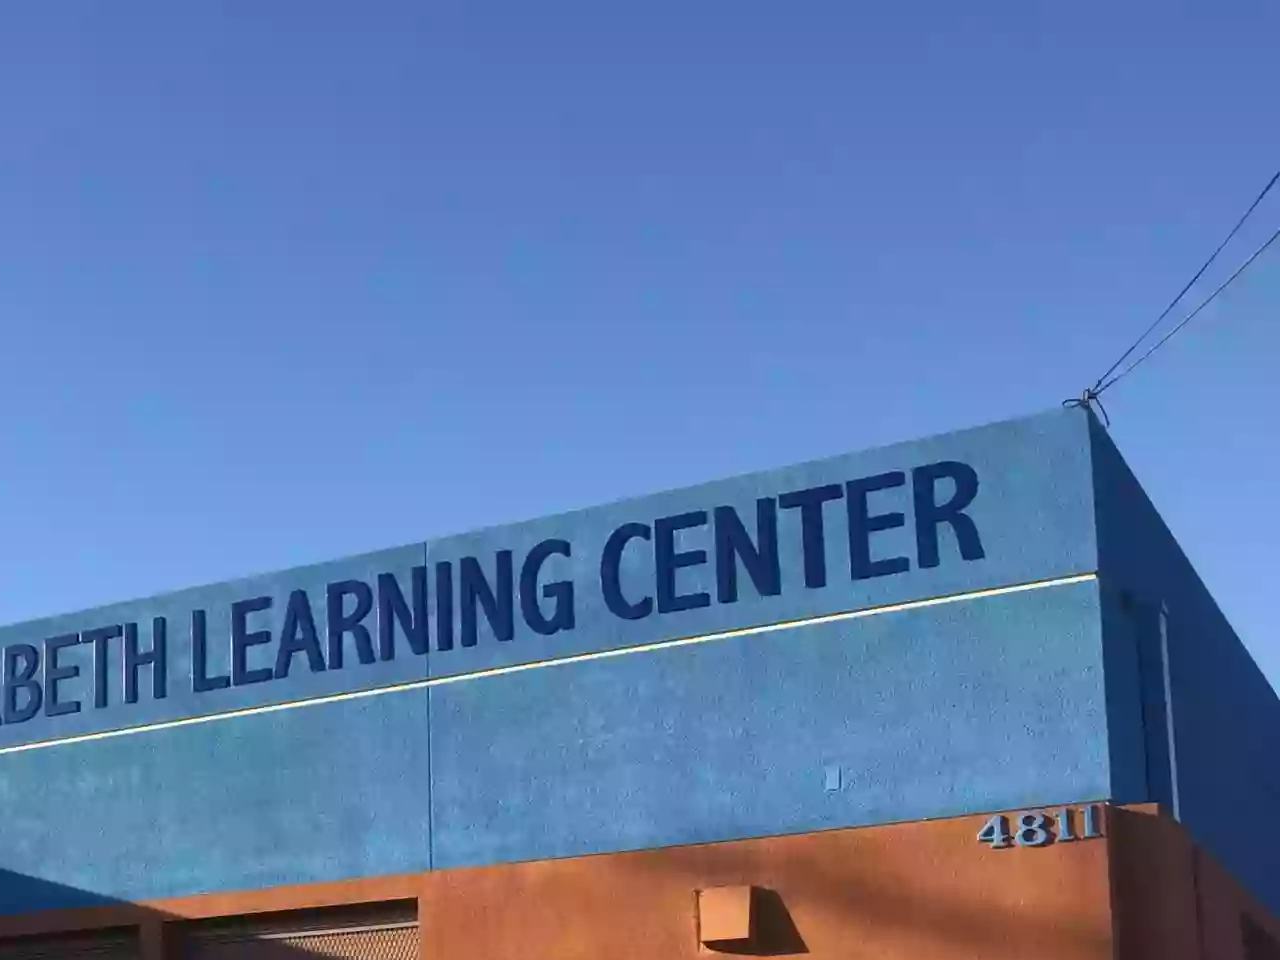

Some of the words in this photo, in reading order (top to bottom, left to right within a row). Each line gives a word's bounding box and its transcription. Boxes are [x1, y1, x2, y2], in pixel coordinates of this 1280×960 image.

[191, 539, 575, 693] LEARNING
[600, 460, 985, 620] CENTER
[976, 805, 1106, 849] 4811
